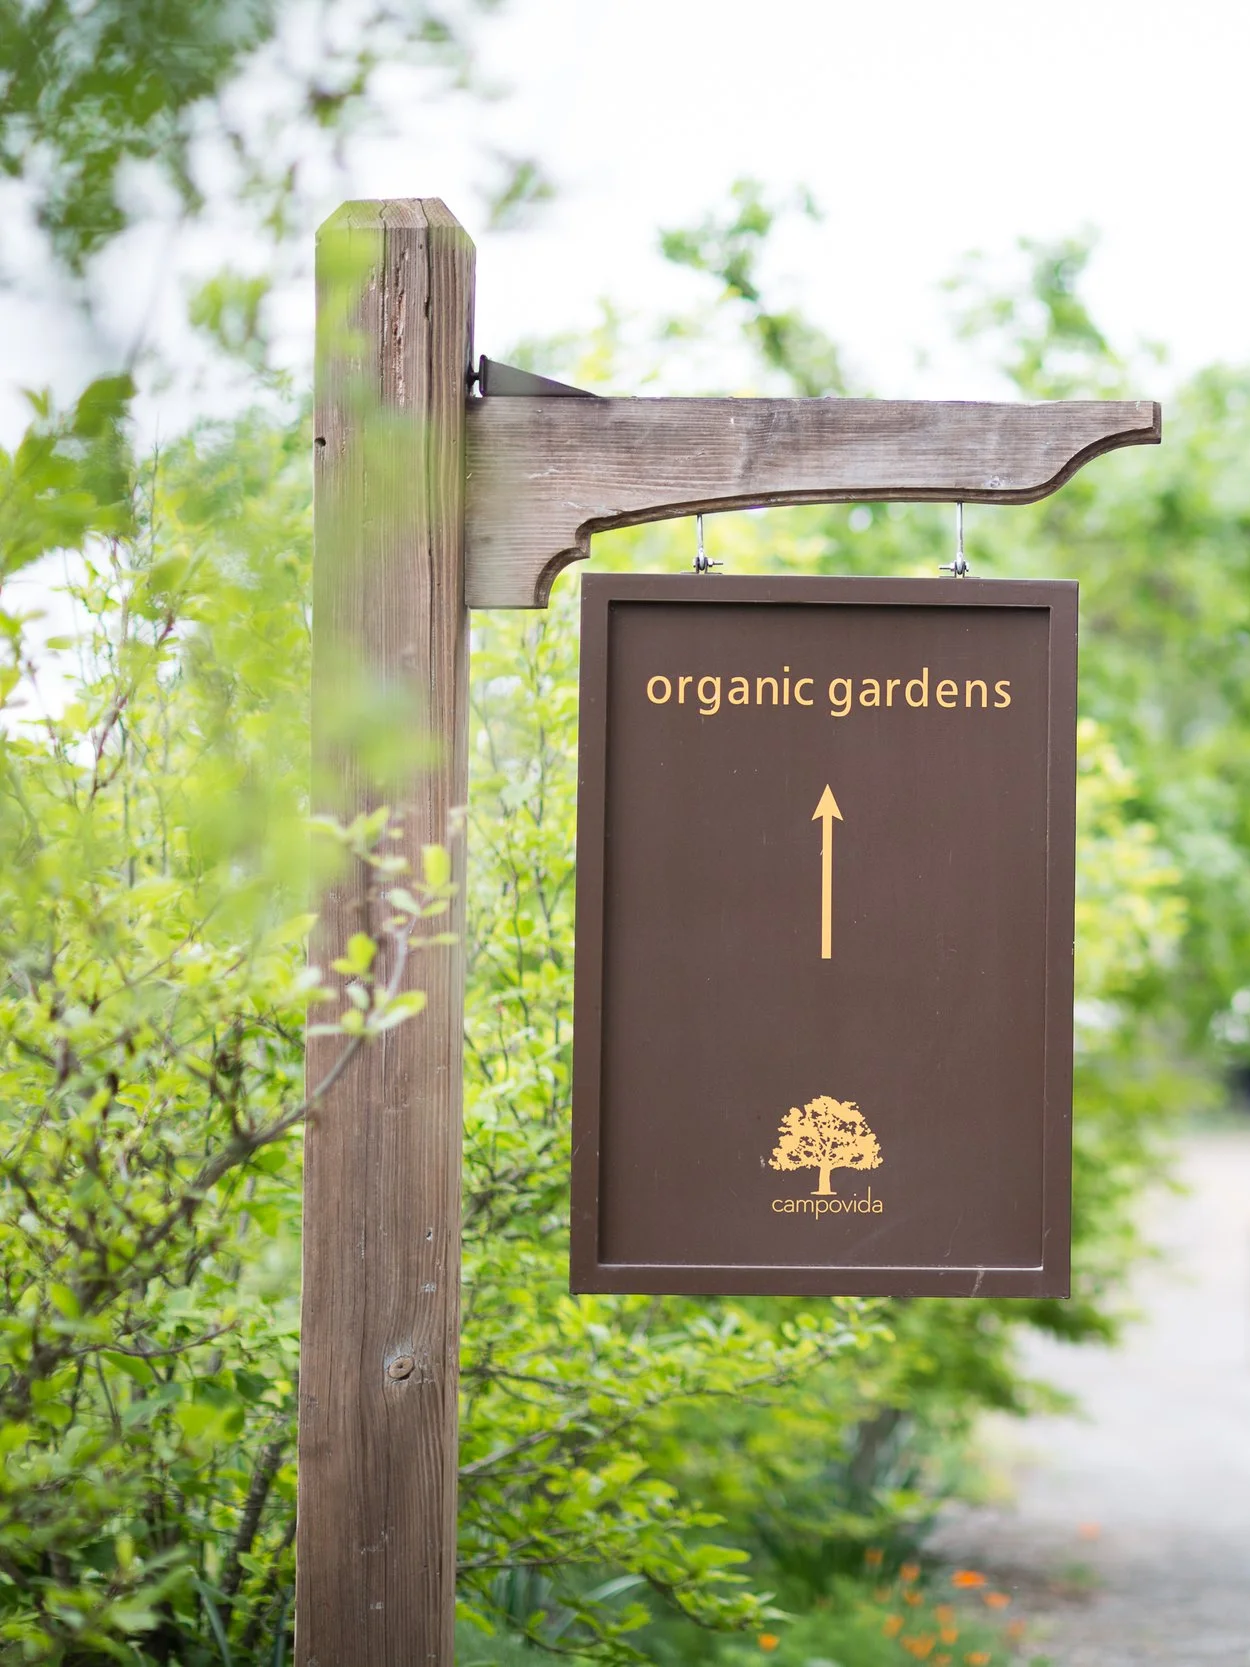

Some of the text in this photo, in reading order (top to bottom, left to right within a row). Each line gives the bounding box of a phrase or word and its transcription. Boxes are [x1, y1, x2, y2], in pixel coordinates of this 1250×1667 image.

[646, 665, 1012, 718] organic gardens
[771, 1186, 883, 1221] campovida
